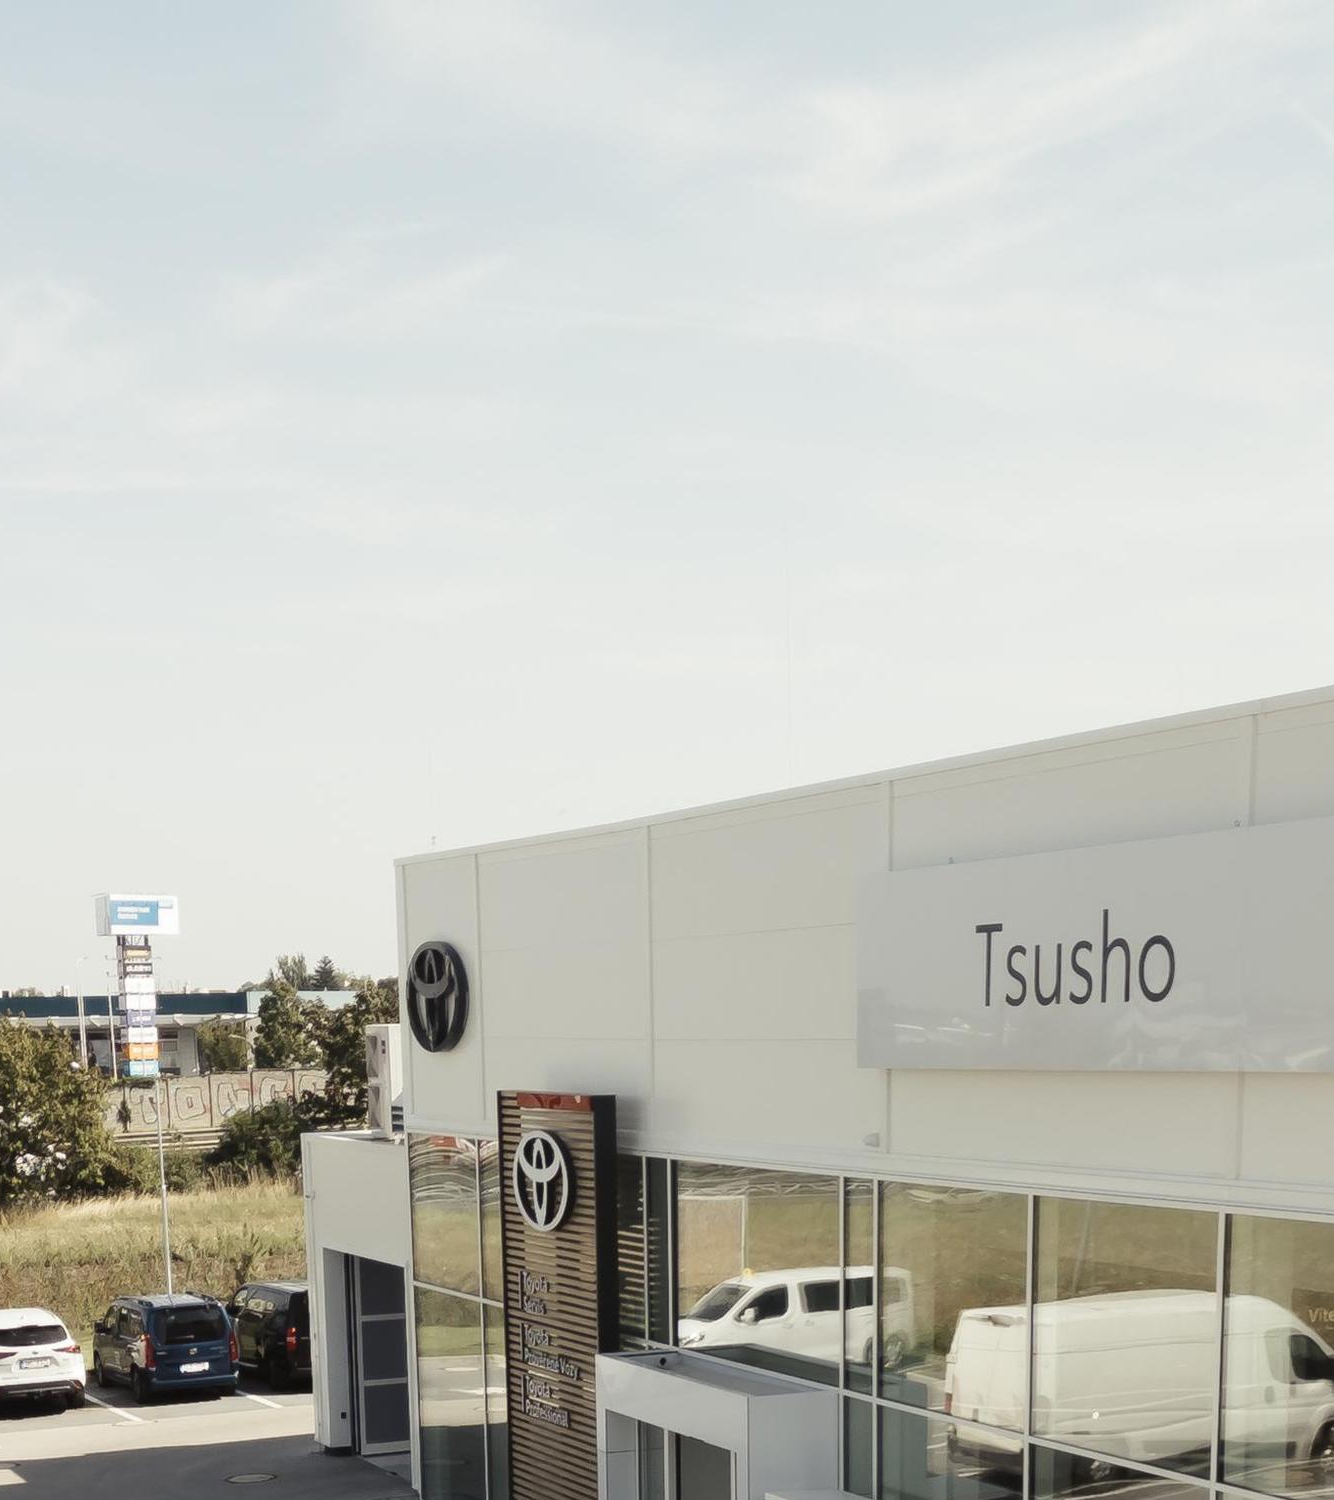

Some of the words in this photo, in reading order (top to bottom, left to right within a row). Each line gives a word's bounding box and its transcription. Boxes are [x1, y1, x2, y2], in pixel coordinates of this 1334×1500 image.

[975, 908, 1176, 1007] Tsusho
[523, 1271, 548, 1294] Toyota
[524, 1324, 549, 1347] Toyota
[525, 1375, 551, 1398] Toyota
